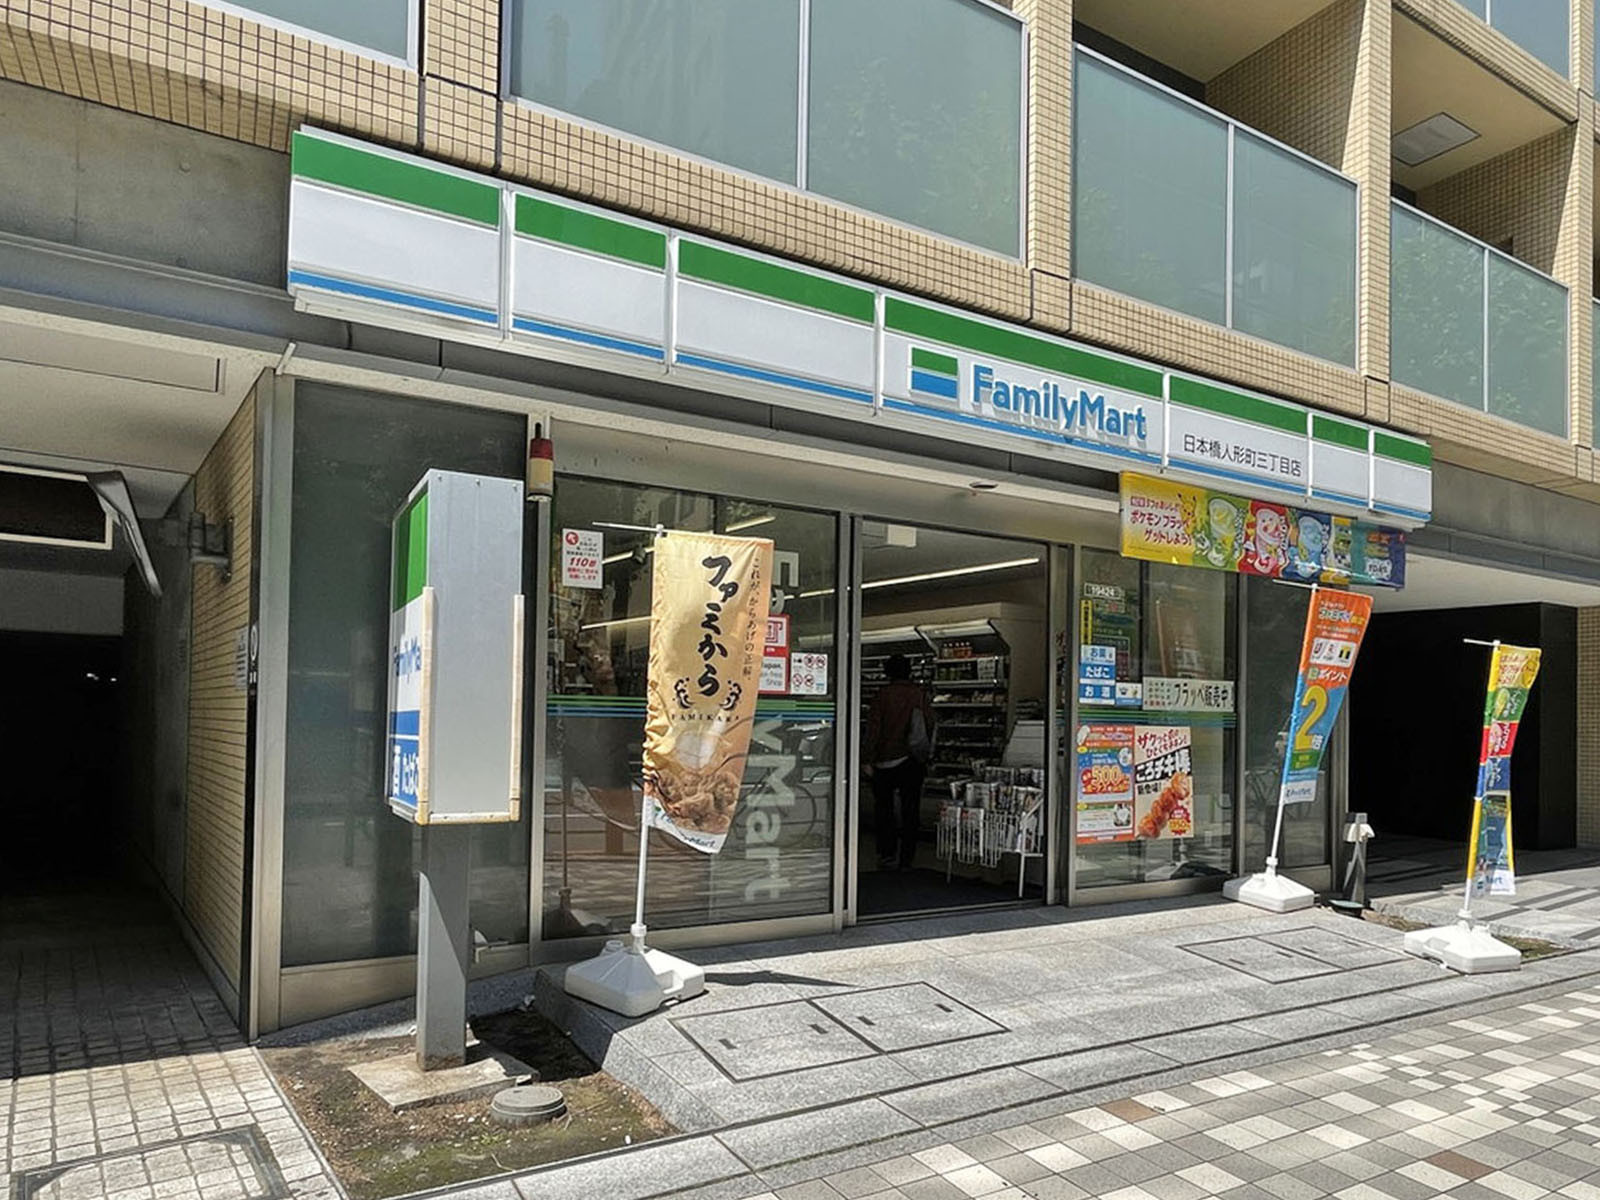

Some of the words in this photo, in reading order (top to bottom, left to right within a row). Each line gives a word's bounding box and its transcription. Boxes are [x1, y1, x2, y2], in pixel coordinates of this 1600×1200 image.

[972, 364, 1147, 441] FamilyMart
[1184, 434, 1302, 477] 日本橋人形町三丁目店
[698, 555, 739, 697] ファミから
[1086, 667, 1111, 678] たばこ
